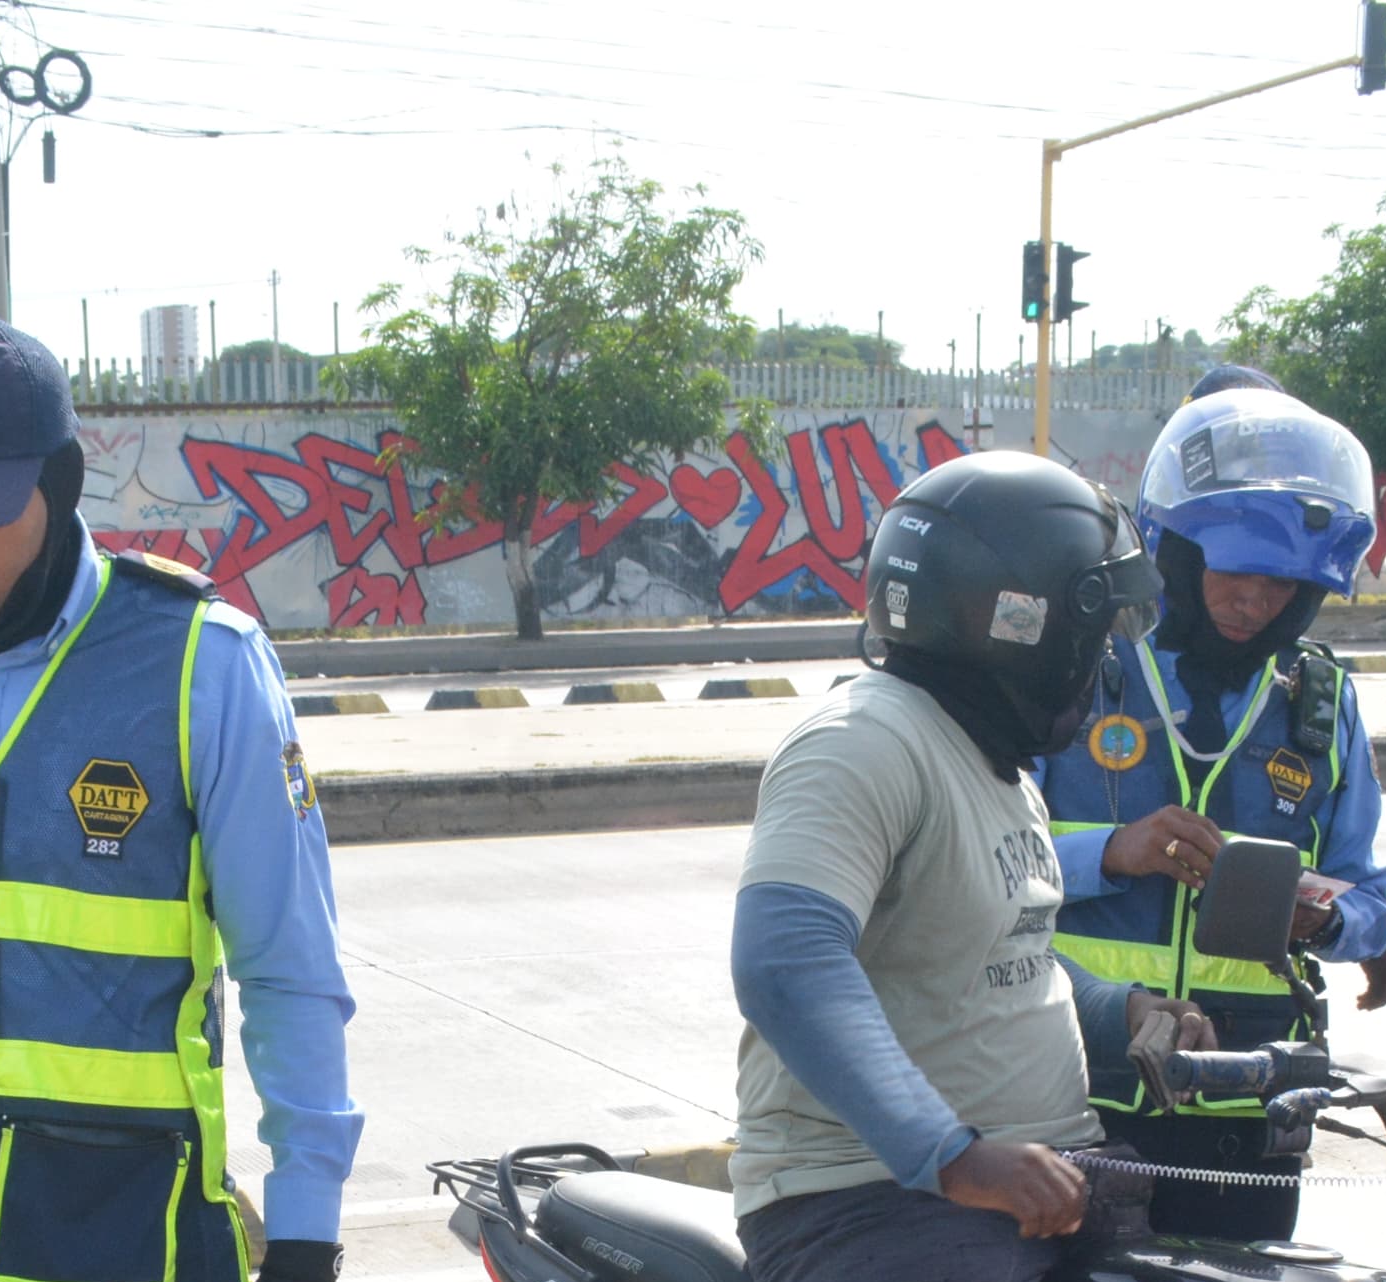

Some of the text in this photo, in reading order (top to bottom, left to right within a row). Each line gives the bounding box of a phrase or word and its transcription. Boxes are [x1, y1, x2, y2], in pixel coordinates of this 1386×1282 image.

[899, 515, 932, 536] ICH
[888, 555, 919, 572] SOLID
[888, 591, 908, 606] DOT
[1273, 764, 1306, 785] DATT
[79, 786, 140, 810] DATT
[1277, 798, 1296, 815] 309
[84, 811, 129, 822] CARTAGENA
[86, 838, 120, 855] 282
